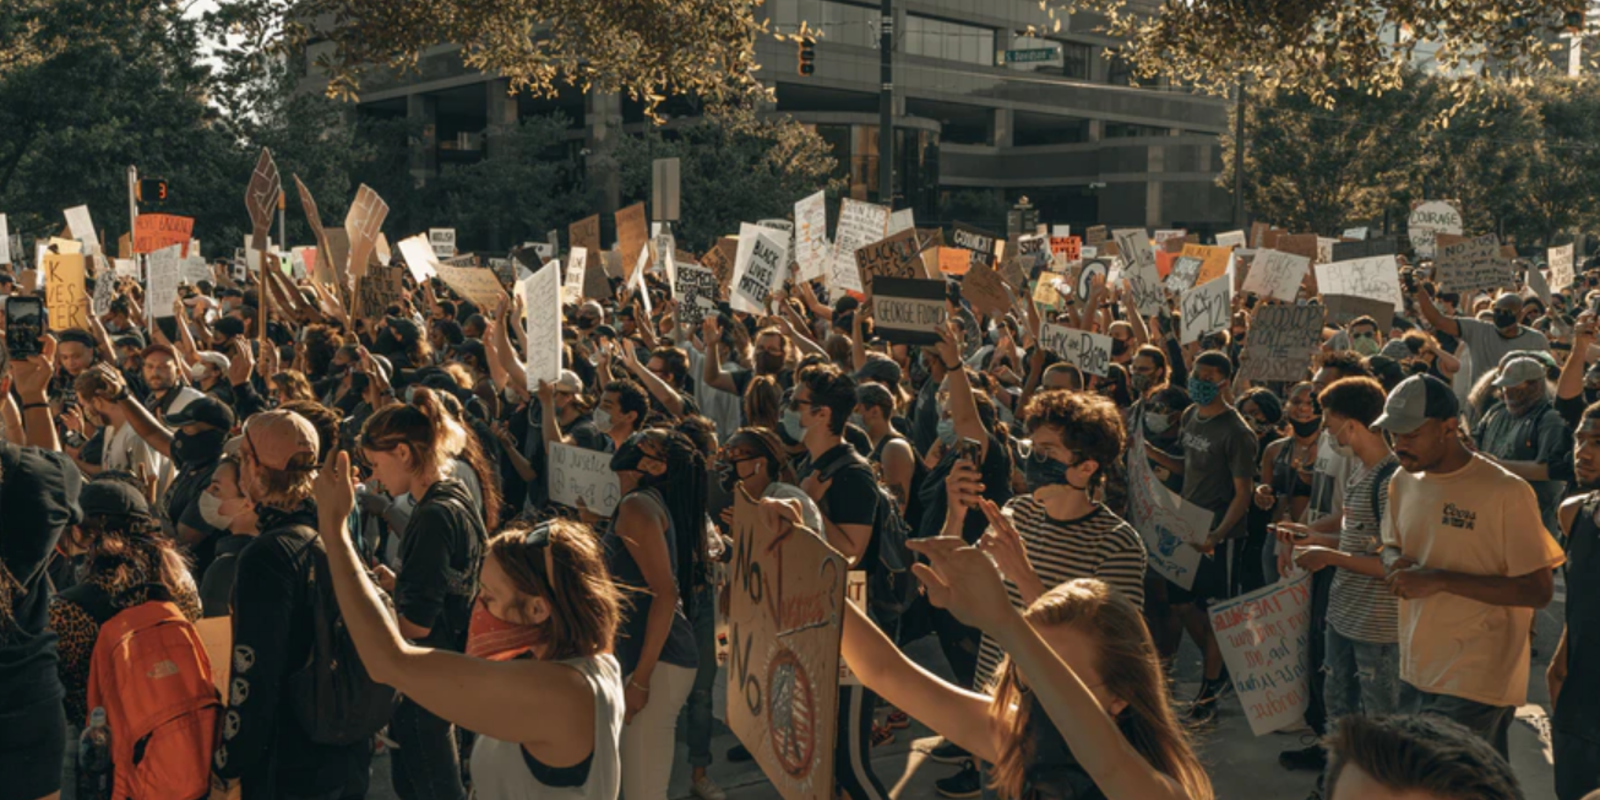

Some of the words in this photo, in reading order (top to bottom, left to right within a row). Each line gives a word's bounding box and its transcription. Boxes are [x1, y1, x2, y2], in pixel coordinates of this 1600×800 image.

[158, 181, 168, 199] 3
[1409, 210, 1458, 226] COURAGE
[752, 239, 779, 269] BLACK
[1021, 237, 1044, 255] STOP
[1445, 244, 1466, 258] NO
[748, 261, 773, 286] LIVES
[1326, 258, 1389, 281] BLACK
[877, 299, 914, 324] GEORGE
[916, 302, 945, 325] FLOYD
[1443, 502, 1477, 520] Coors
[730, 621, 761, 717] No
